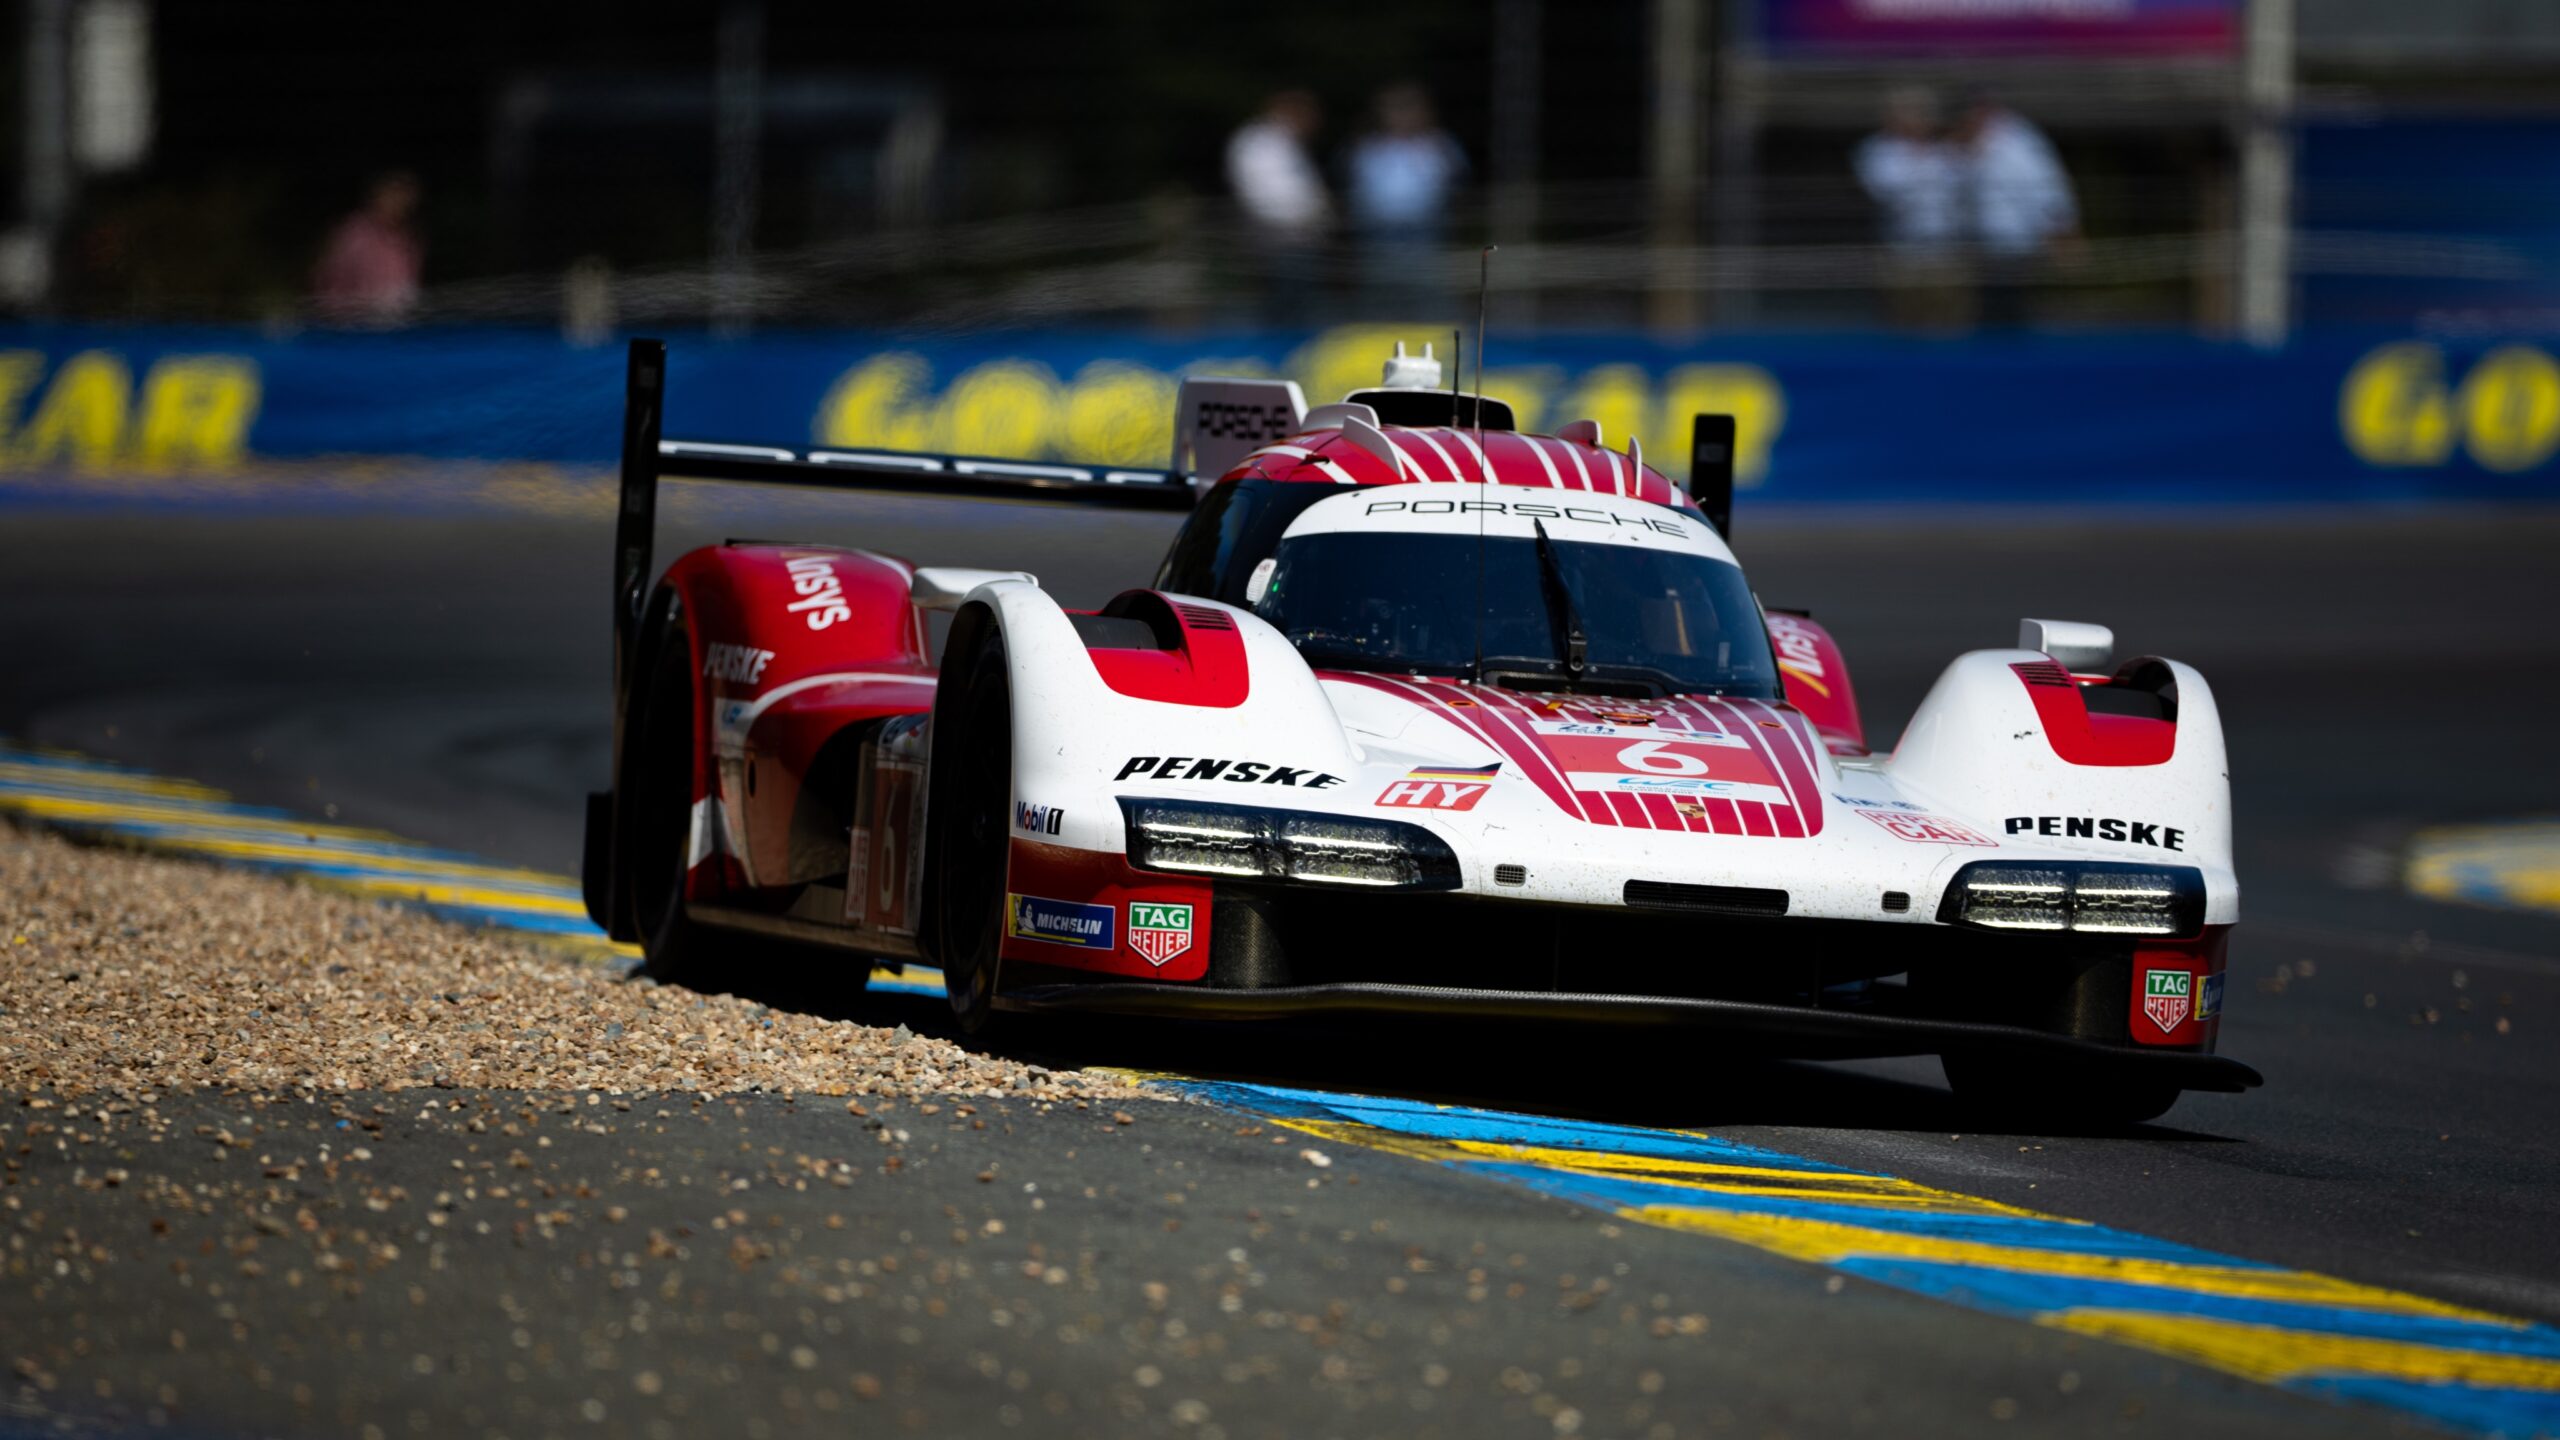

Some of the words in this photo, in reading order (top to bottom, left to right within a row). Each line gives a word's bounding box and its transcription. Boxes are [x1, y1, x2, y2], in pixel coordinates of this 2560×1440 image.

[1198, 402, 1288, 439] PORSCHE
[1365, 500, 1690, 540] PORSCHE
[703, 641, 776, 686] PENSKE
[1113, 756, 1347, 789] PENSKE
[1616, 740, 1709, 775] 6
[1380, 782, 1485, 807] HY
[1617, 777, 1735, 791] WEC
[1016, 801, 1048, 833] Mobil
[1048, 809, 1063, 835] 1
[1887, 821, 1987, 844] CAR
[2005, 816, 2184, 852] PENSKE
[1036, 912, 1102, 935] MICHELIN
[1134, 907, 1186, 927] TAG
[1132, 929, 1187, 961] HEUER
[2151, 975, 2187, 993] TAG
[2147, 998, 2188, 1027] HEUER
